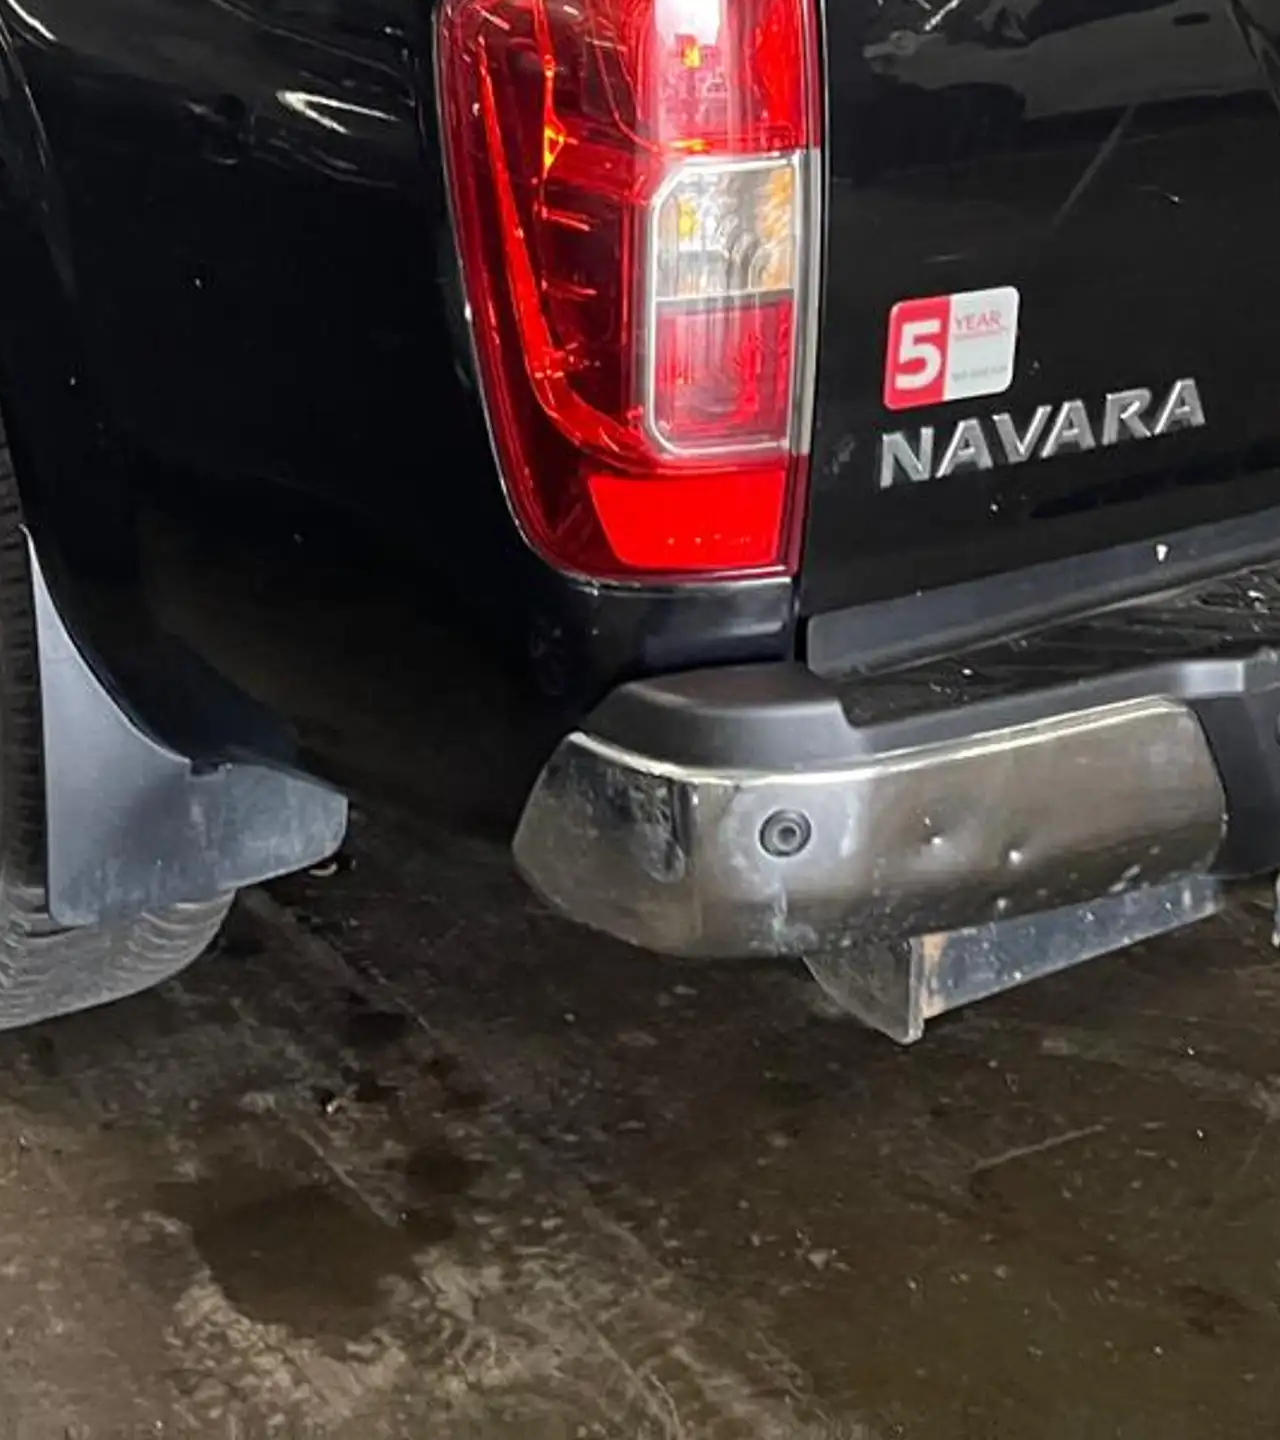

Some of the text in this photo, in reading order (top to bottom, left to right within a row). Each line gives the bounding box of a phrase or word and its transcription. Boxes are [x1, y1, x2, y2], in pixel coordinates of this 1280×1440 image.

[894, 309, 1002, 391] 5 YEAR
[880, 377, 1208, 489] NAVARA
